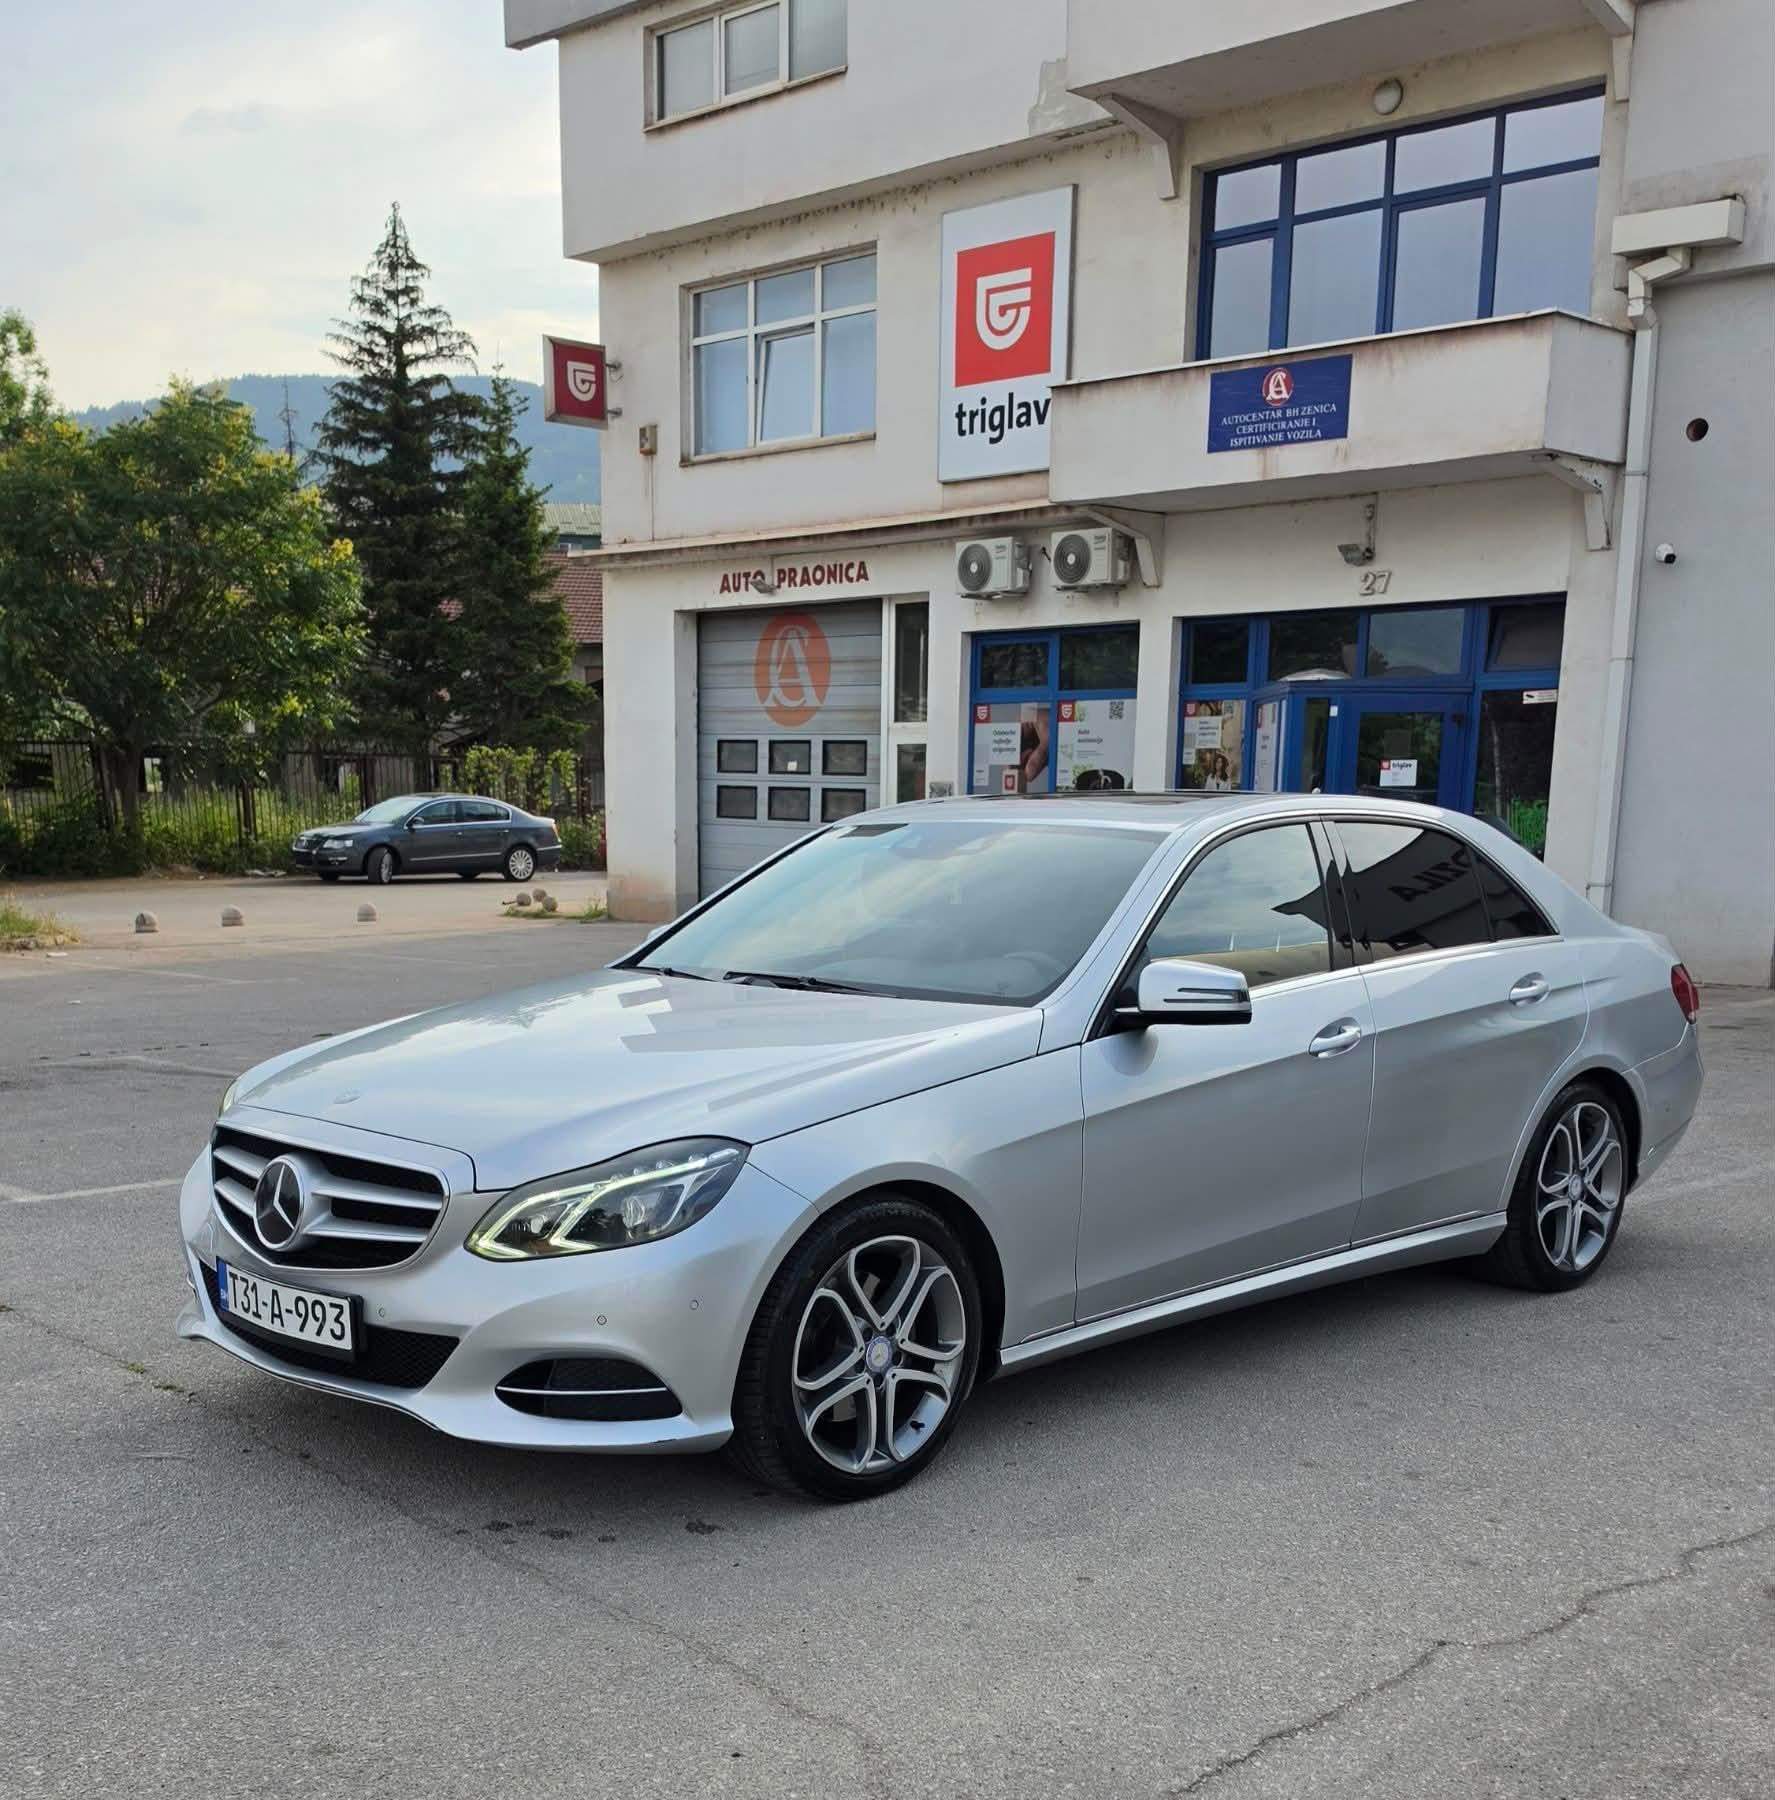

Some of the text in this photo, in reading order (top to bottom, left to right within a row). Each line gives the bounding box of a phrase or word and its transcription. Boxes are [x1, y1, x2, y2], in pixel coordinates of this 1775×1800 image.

[955, 392, 1051, 445] triglav
[1221, 403, 1337, 426] AUTOCENTAR BH ZENICA
[1236, 417, 1316, 435] CERTIFICIRANJE I
[1230, 429, 1322, 447] ISPITIVANJE VOZILA
[776, 560, 869, 589] PRAONICA
[1360, 570, 1392, 597] 27
[229, 1271, 346, 1341] T31-A-993
